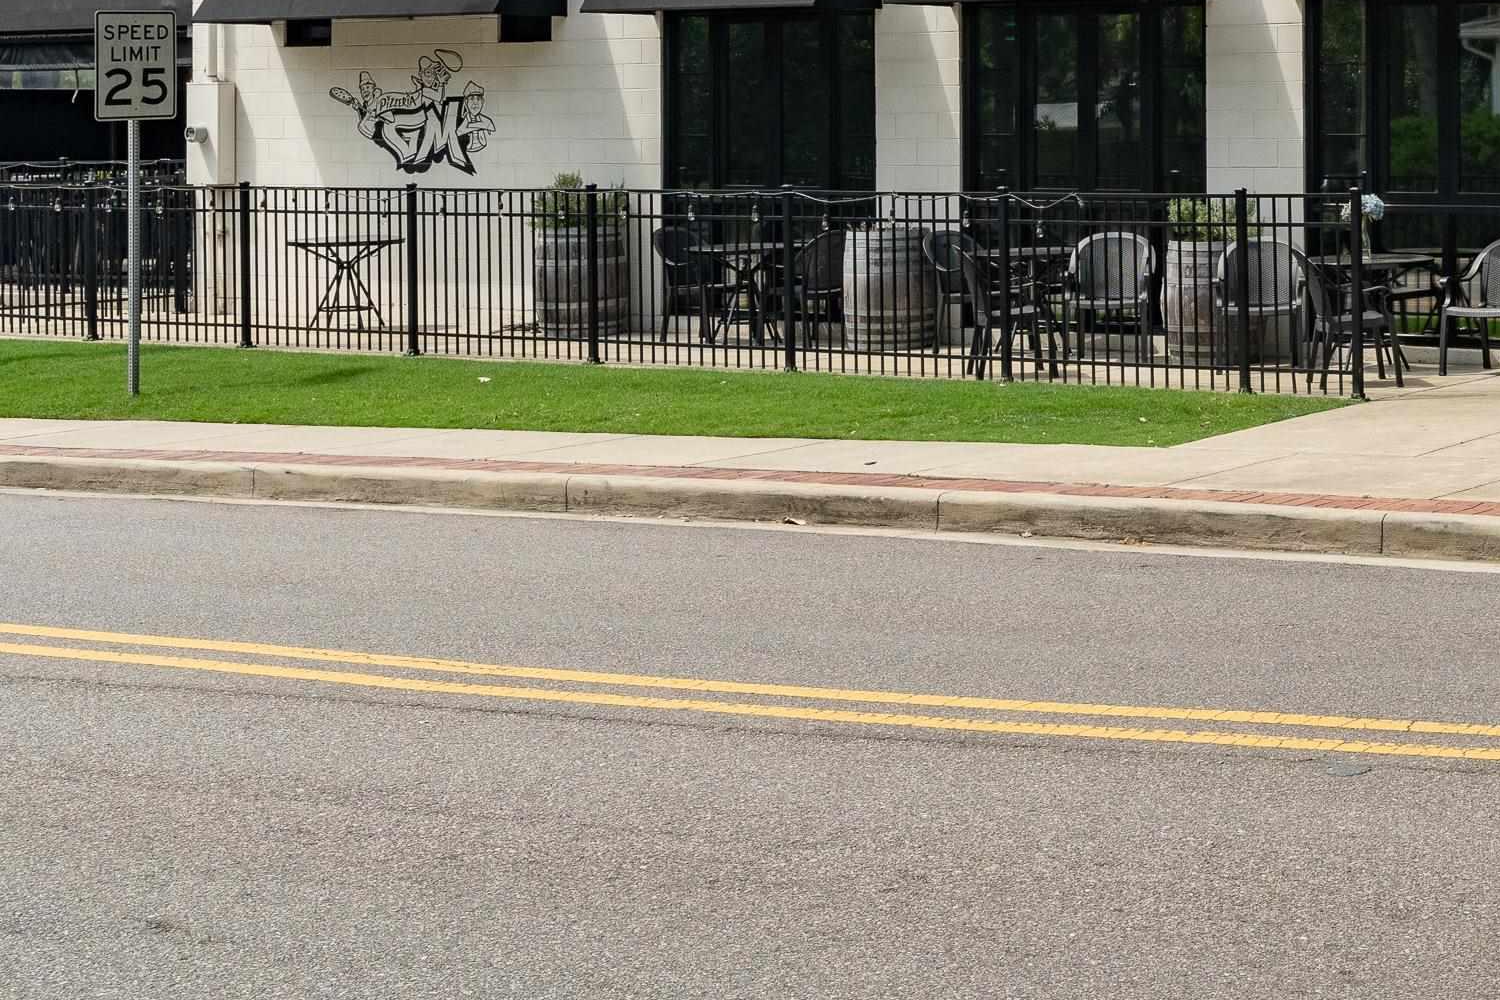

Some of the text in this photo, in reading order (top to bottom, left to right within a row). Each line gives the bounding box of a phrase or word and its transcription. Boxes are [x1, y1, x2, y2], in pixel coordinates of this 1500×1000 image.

[104, 25, 169, 40] SPEED
[111, 46, 161, 62] LIMIT
[104, 68, 168, 106] 25
[374, 96, 478, 176] GM
